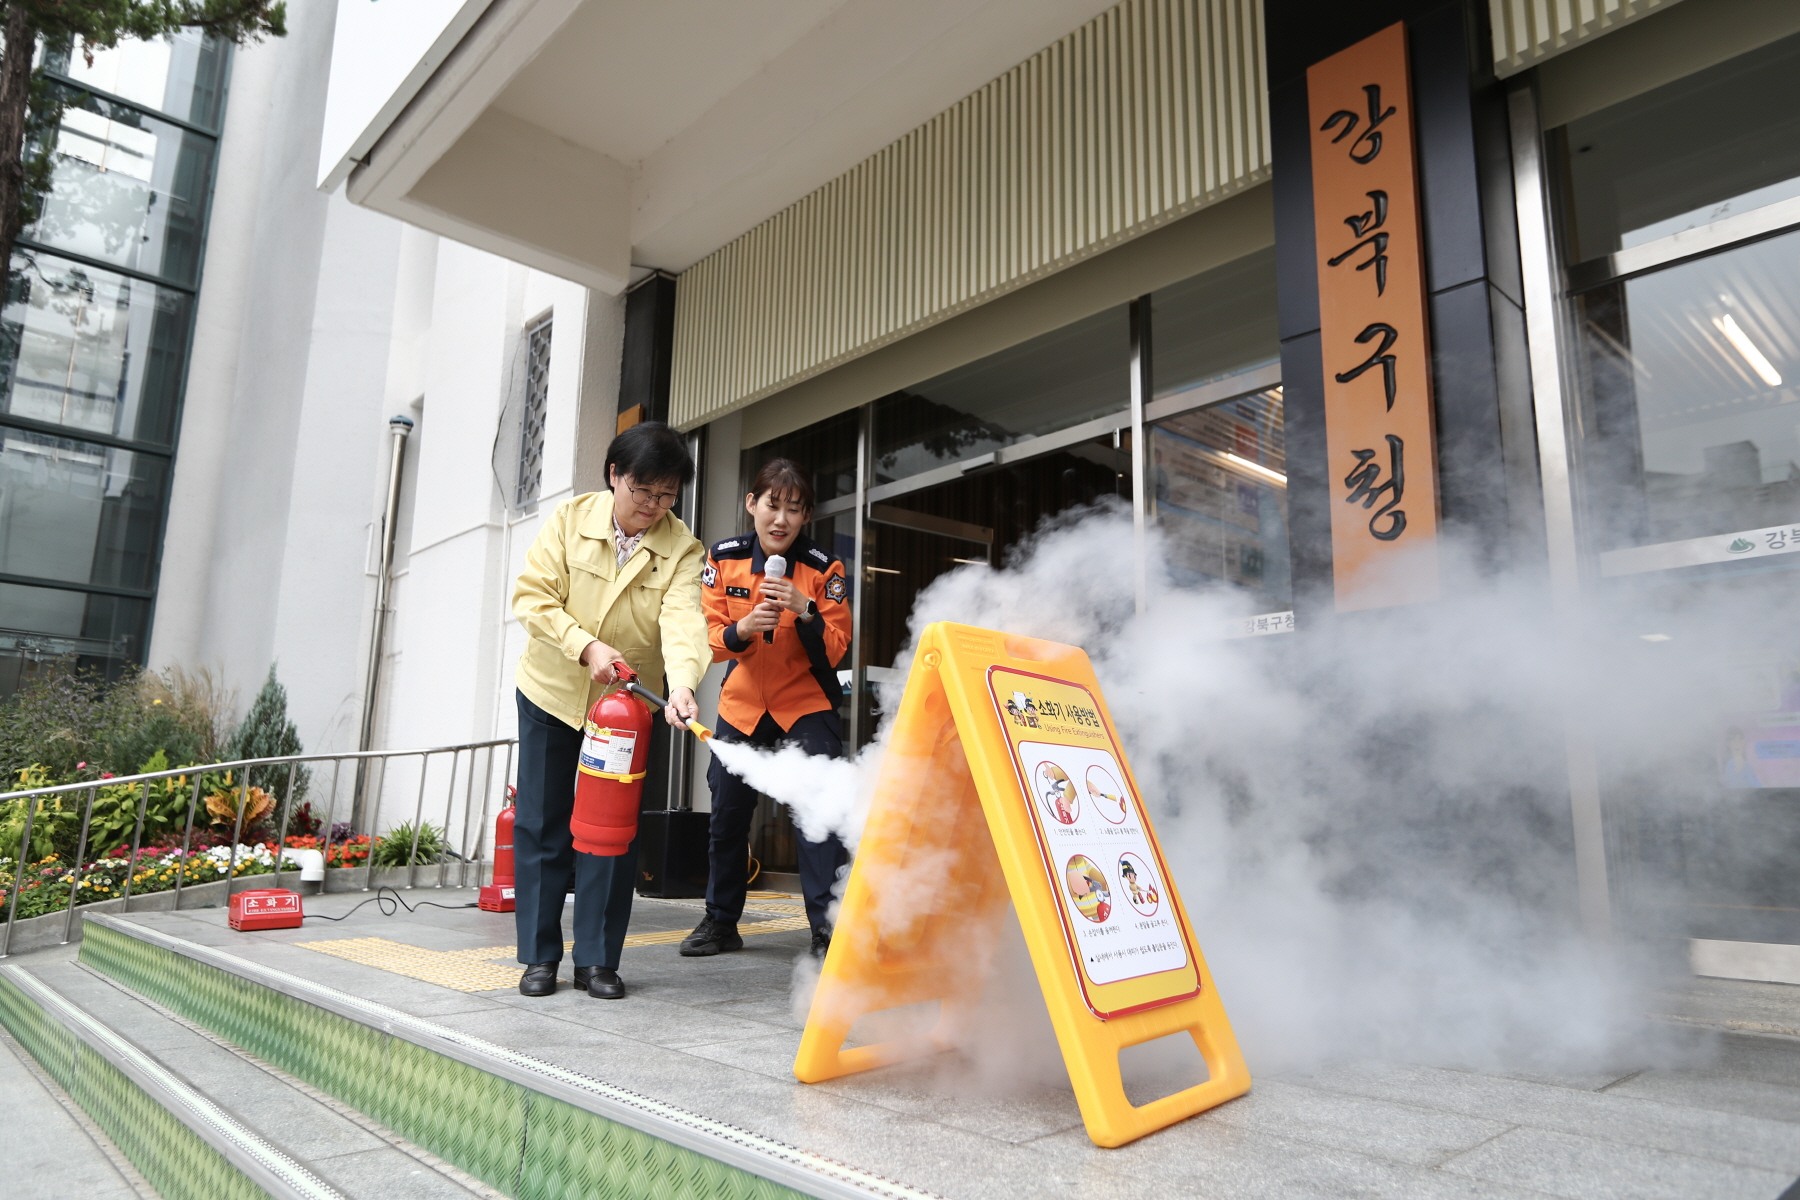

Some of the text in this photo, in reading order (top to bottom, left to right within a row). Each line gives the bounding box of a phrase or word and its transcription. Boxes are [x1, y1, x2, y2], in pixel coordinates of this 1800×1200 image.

[1320, 84, 1407, 541] 강북구청
[1244, 614, 1295, 634] 강북구청
[1038, 700, 1099, 727] 소화기 사용방법
[1044, 725, 1061, 734] Using
[1061, 725, 1072, 735] Fire
